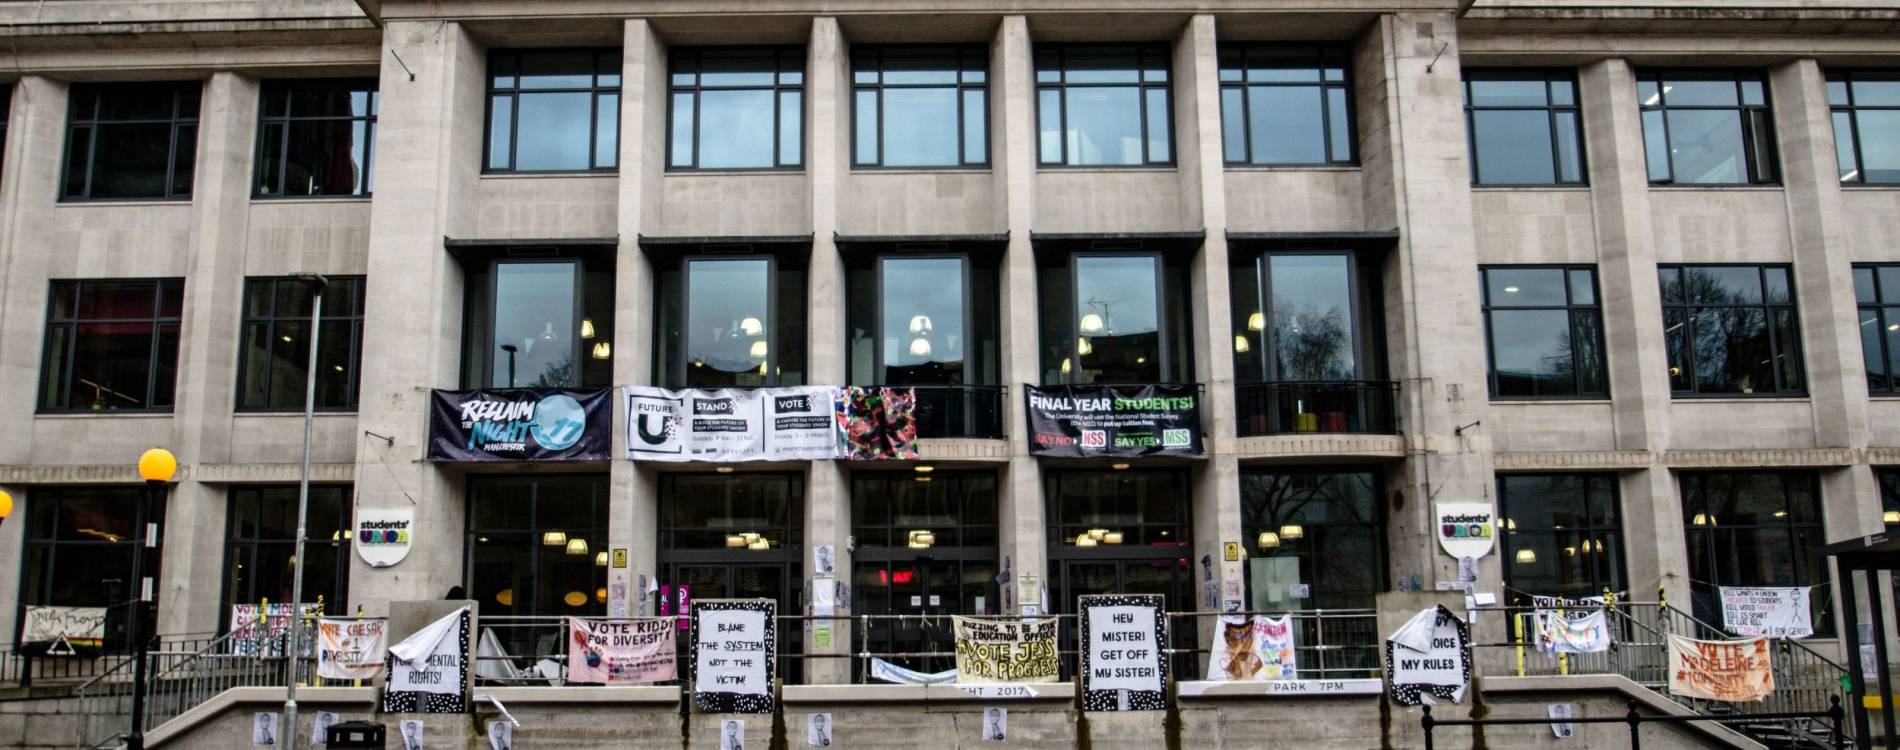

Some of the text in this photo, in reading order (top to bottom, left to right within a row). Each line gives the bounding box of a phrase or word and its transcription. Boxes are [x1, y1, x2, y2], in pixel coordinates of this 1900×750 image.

[639, 403, 673, 413] FUTURE
[696, 403, 727, 411] STAND
[779, 400, 803, 409] VOTE
[1030, 395, 1194, 411] FINAL YEAR STUDENTS!
[461, 400, 535, 422] RECLAIM
[1056, 413, 1082, 421] University
[1161, 412, 1179, 420] Survey
[1122, 419, 1141, 427] tuition
[468, 419, 538, 450] NIGHT
[1035, 434, 1073, 445] SAY NO
[1084, 431, 1104, 446] NSS
[1165, 430, 1189, 444] MSS
[1114, 437, 1156, 447] SAY YES
[1442, 513, 1490, 523] students'
[361, 520, 409, 529] students'
[1113, 613, 1133, 623] HEY
[347, 620, 384, 636] CAESAR
[588, 622, 630, 634] VOTE
[718, 623, 746, 632] BLAME
[962, 621, 999, 632] BUZZING
[1005, 624, 1016, 633] TO
[1022, 623, 1031, 632] BE
[588, 631, 671, 646] FOR DIVERSITY
[973, 631, 1018, 641] EDUCATION
[1102, 632, 1145, 642] MISTER!
[700, 640, 763, 651] THE SYSTEM
[954, 638, 1055, 662] #VOTE JESS
[1695, 641, 1743, 658] VOTE
[1101, 650, 1148, 660] GET OFF
[709, 659, 753, 667] NOT THE
[965, 657, 992, 677] FOR
[997, 657, 1059, 680] PROGRESS
[1402, 659, 1455, 670] MY RULES
[408, 671, 442, 684] RIGHTS!
[1095, 667, 1155, 678] MY SISTER!
[997, 687, 1025, 696] 2017
[1274, 682, 1345, 692] PARK 7PM
